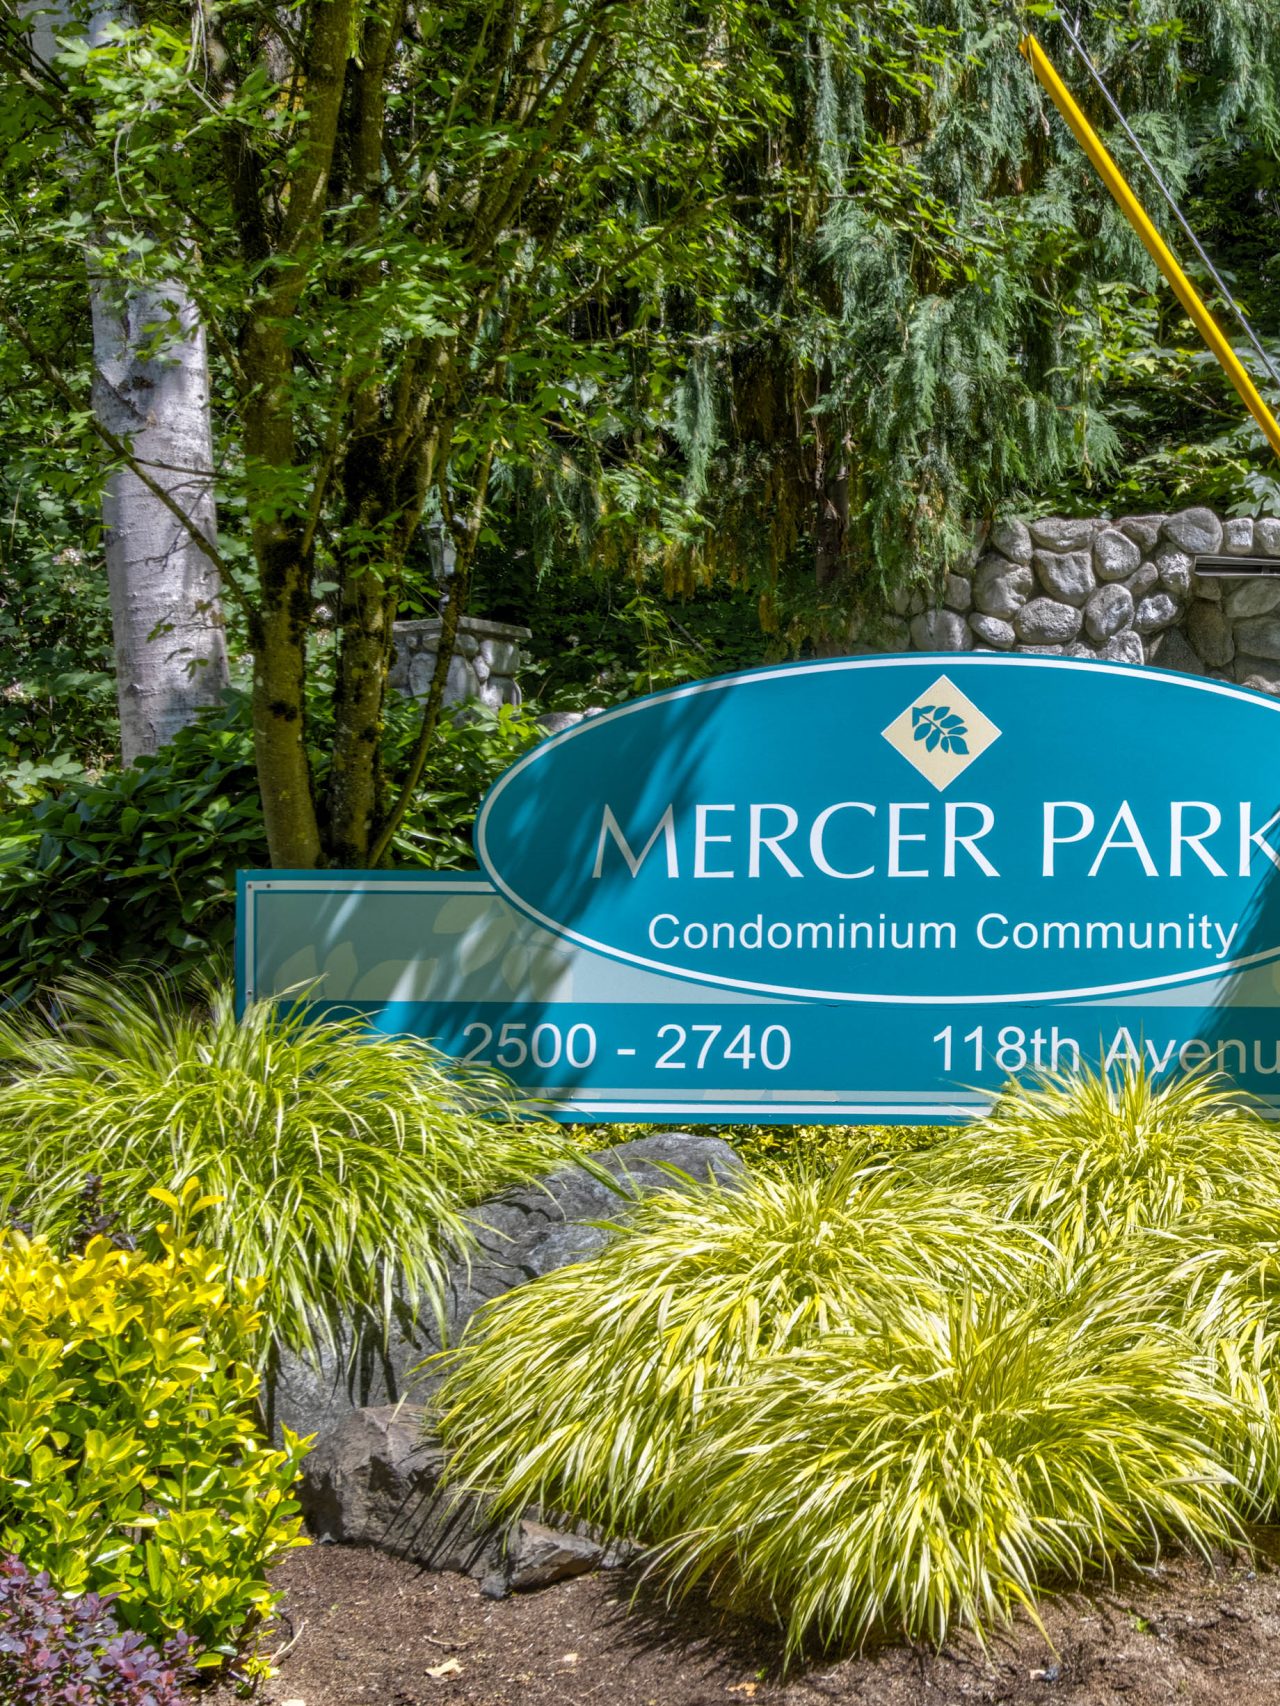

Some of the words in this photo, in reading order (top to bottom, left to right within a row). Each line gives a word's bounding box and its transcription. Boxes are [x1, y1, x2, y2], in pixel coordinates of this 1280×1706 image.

[592, 801, 1001, 879] MERCER
[648, 913, 957, 950] Condominium
[976, 913, 1239, 959] Community
[461, 1022, 598, 1070] 2500
[654, 1023, 792, 1071] 2740
[932, 1024, 1080, 1073] 118th
